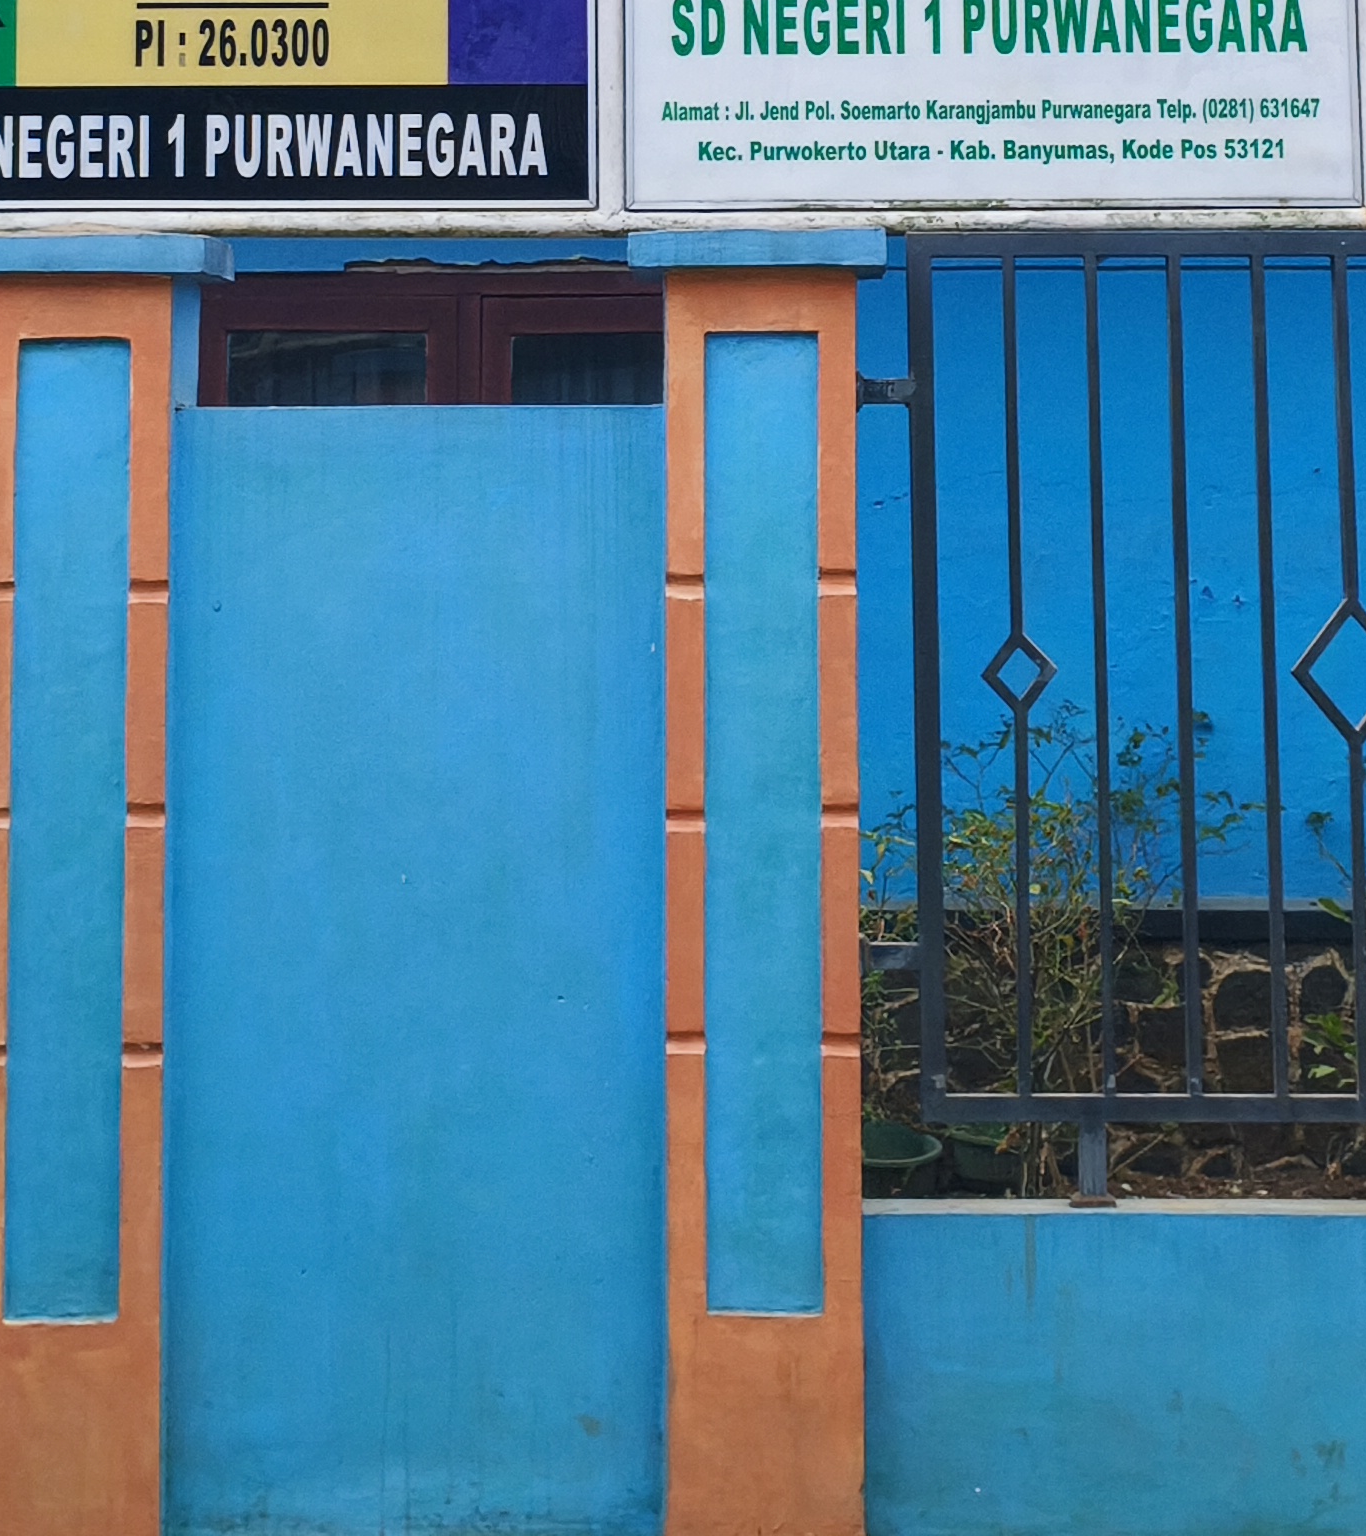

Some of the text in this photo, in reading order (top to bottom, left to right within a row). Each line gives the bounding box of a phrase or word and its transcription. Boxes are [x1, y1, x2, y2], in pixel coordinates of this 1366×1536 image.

[135, 20, 164, 66] PI
[199, 19, 329, 67] 26.0300
[662, 102, 719, 121] Alamat
[735, 101, 754, 120] Jl.
[760, 101, 798, 120] Jend
[806, 101, 834, 120] Pol.
[841, 100, 920, 120] Soemarto
[927, 100, 1035, 124] Karangjambu
[1042, 100, 1151, 124] Purwanegara
[1157, 99, 1196, 123] Telp.
[1203, 99, 1254, 123] (0281)
[1260, 98, 1319, 118] 631647
[168, 114, 184, 177] 1
[206, 113, 547, 177] PURWANEGARA
[699, 141, 742, 161] Kec.
[750, 141, 866, 160] Purwokerto
[875, 141, 930, 160] Utara
[951, 140, 995, 160] Kab.
[1004, 140, 1114, 164] Banyumas,
[1123, 139, 1173, 159] Kode
[1181, 139, 1217, 159] Pos
[1225, 139, 1283, 158] 53121
